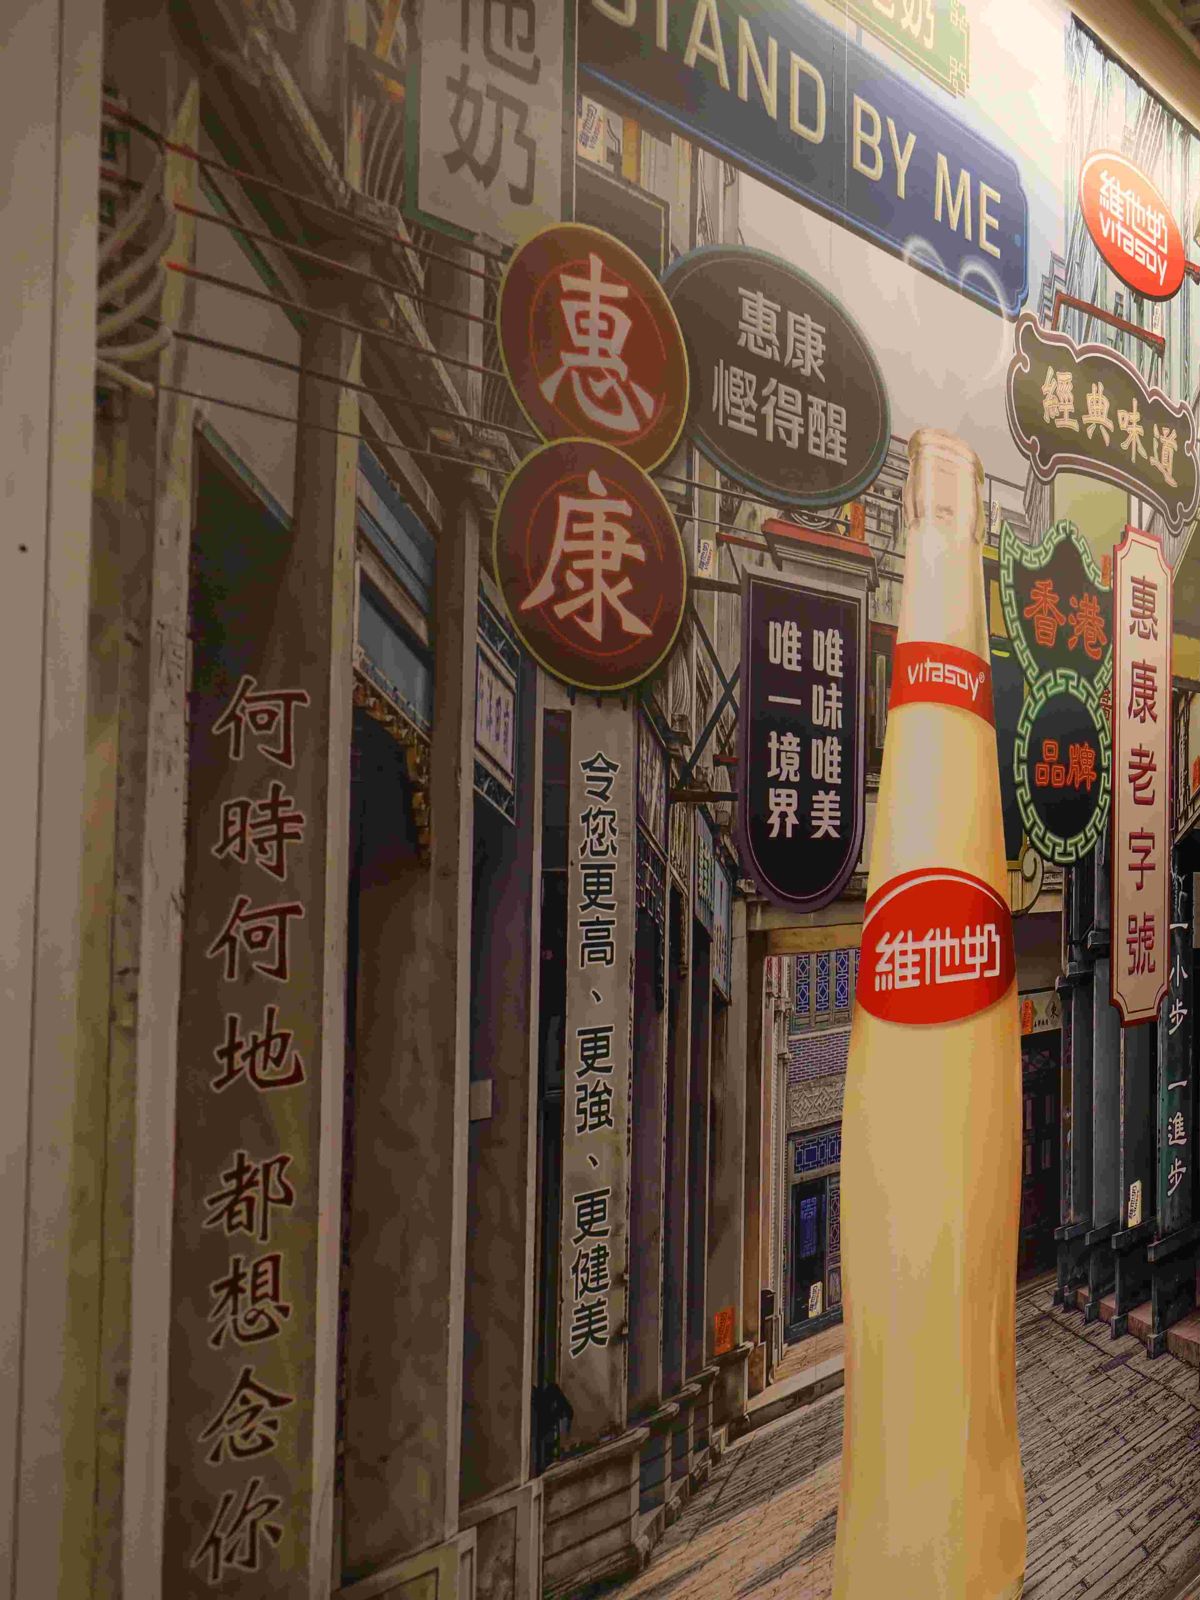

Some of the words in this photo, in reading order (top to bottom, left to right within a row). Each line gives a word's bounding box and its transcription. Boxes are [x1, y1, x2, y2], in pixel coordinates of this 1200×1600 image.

[852, 93, 916, 200] BY
[934, 152, 1001, 259] ME
[1098, 169, 1168, 253] 維他奶
[736, 286, 826, 384] 惠康
[711, 358, 848, 467] 慳得醒
[1041, 365, 1179, 489] 經典味道
[1024, 579, 1108, 661] 香港
[767, 621, 802, 839] 唯一境界
[811, 628, 845, 839] 唯味唯美
[1035, 739, 1098, 792] 品牌
[1126, 575, 1160, 977] 惠康老字號
[874, 923, 1000, 992] 維他奶
